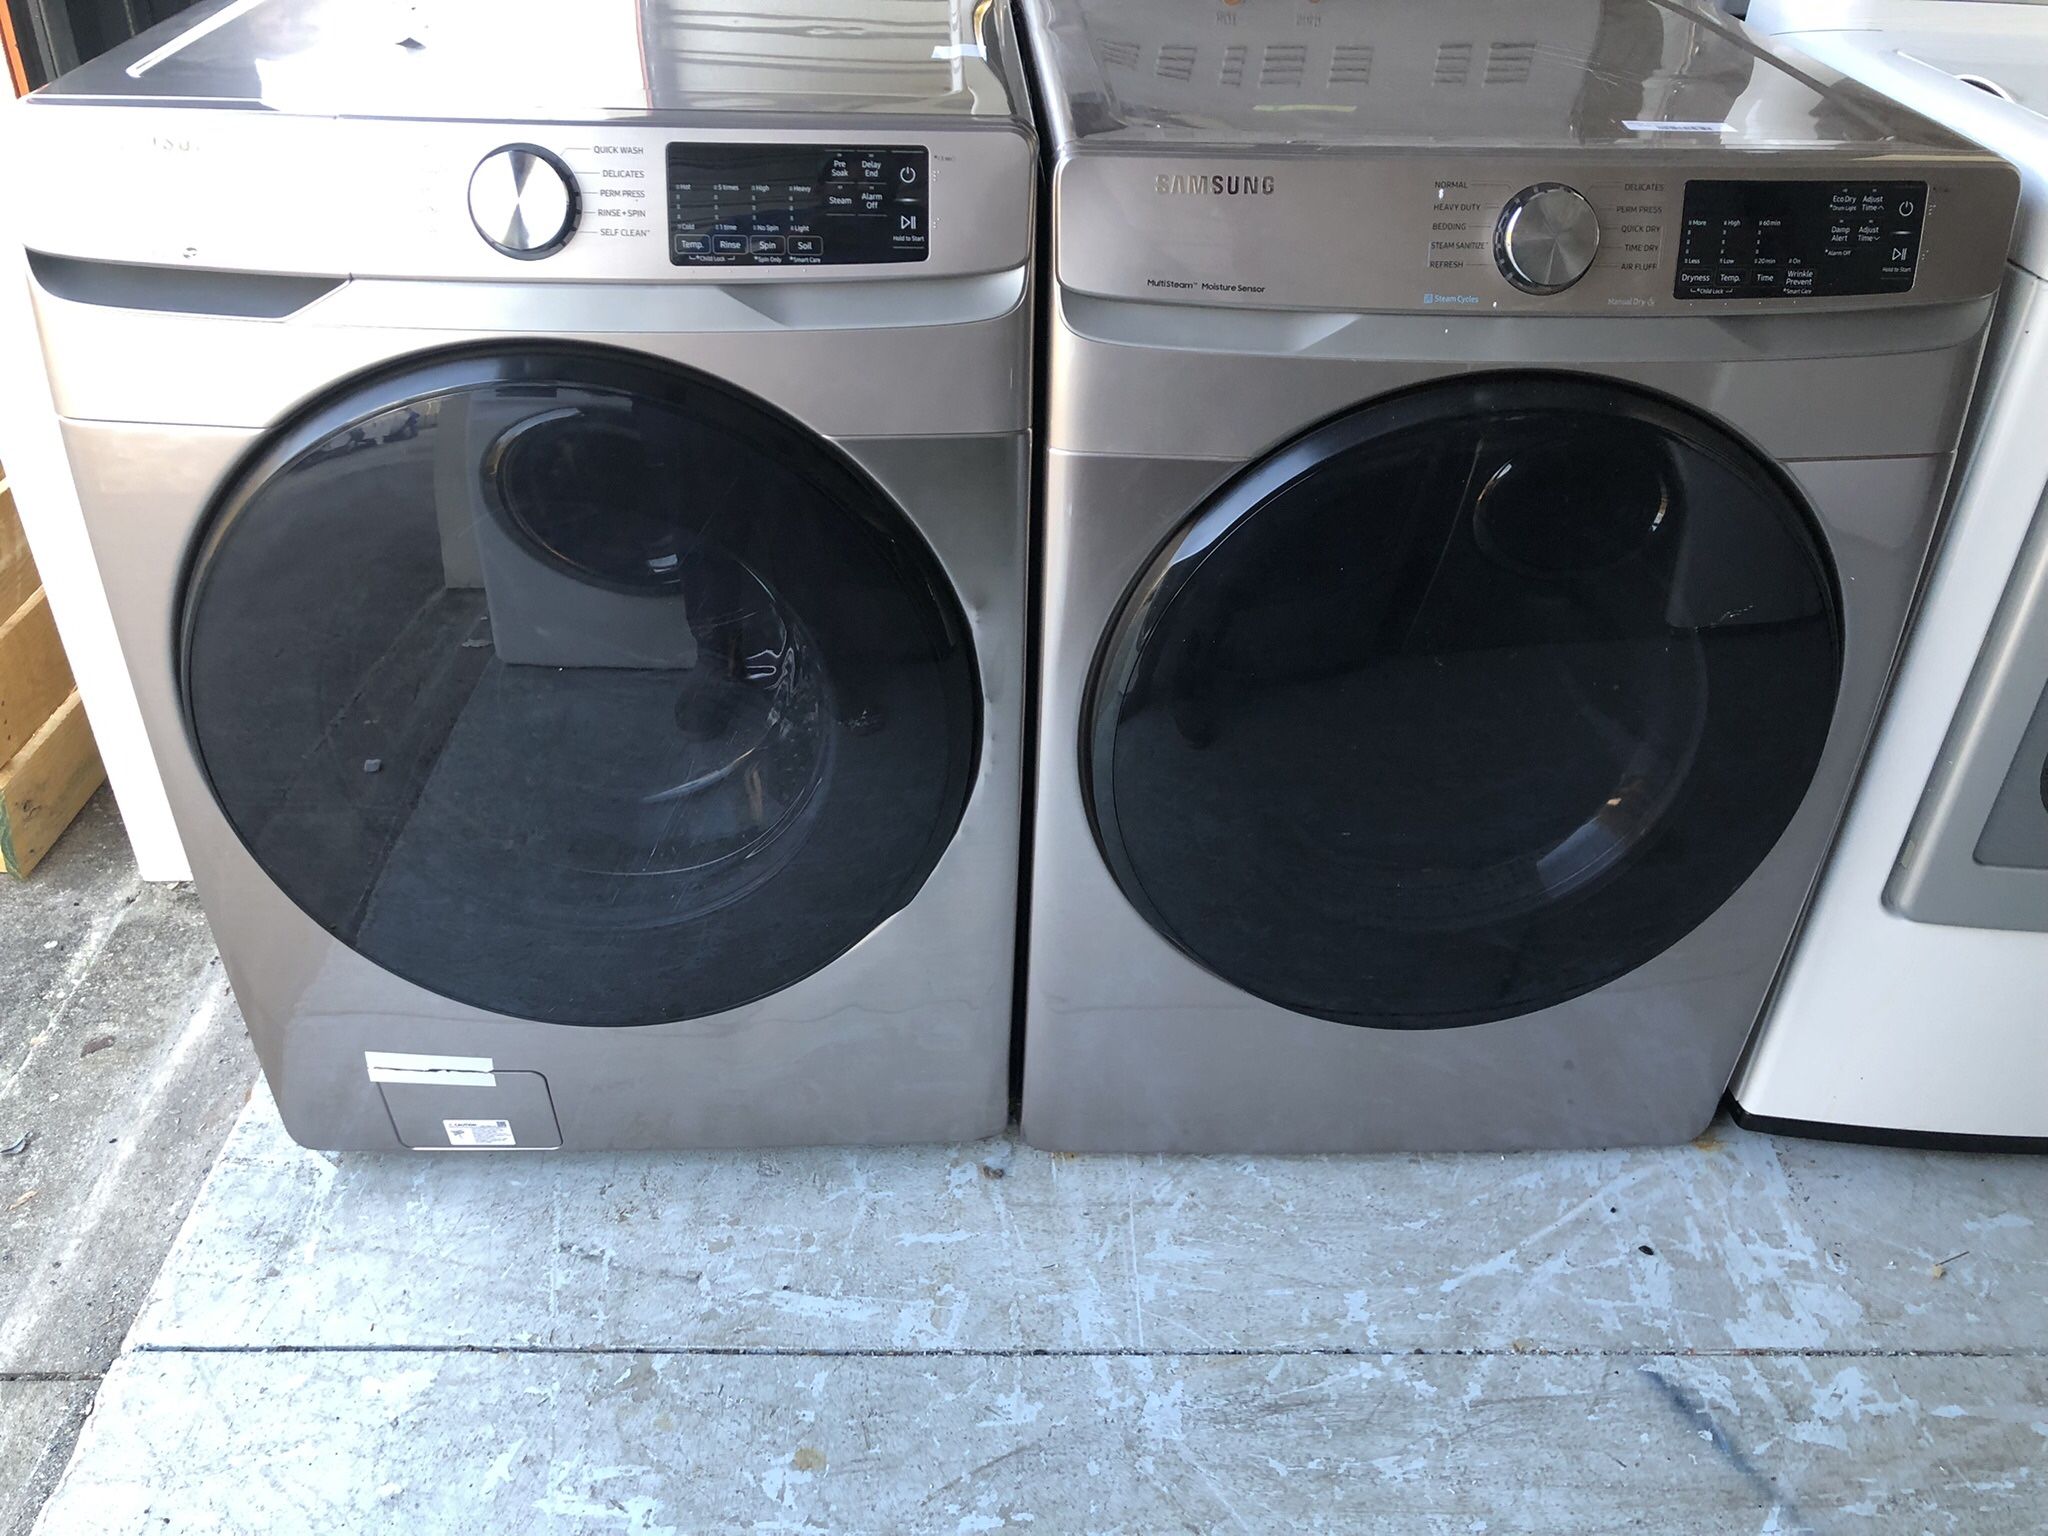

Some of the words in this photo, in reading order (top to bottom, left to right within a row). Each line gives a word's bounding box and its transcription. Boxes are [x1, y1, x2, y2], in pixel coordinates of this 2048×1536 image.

[593, 145, 619, 155] QUICK
[619, 146, 644, 155] WASH
[833, 160, 846, 168] Pre
[861, 160, 881, 170] Delay
[602, 169, 645, 179] DELICATES
[831, 168, 848, 177] Soak
[865, 169, 879, 177] End
[680, 183, 692, 191] Hot
[756, 184, 771, 193] High
[794, 184, 812, 194] Heavy
[1154, 174, 1275, 195] SAMSUNG
[1434, 180, 1469, 189] NORMAL
[1624, 183, 1665, 192] DELICATES
[600, 188, 621, 197] PERM
[622, 189, 645, 198] PRESS
[861, 192, 883, 201] Alarm
[828, 196, 853, 205] Steam
[1862, 195, 1884, 204] Adjust
[865, 201, 878, 210] Off
[1433, 203, 1459, 212] HEAVY
[1460, 203, 1481, 212] DUTY
[1862, 203, 1878, 212] Time
[597, 208, 621, 217] RINSE
[627, 209, 646, 218] SPIN
[681, 223, 695, 231] Cold
[1432, 222, 1467, 231] BEDDING
[1727, 219, 1741, 228] High
[600, 228, 619, 237] SELF
[766, 224, 780, 233] Spin
[794, 224, 810, 233] Light
[1621, 224, 1645, 233] QUICK
[1645, 225, 1660, 233] DRY
[1831, 226, 1851, 235] Damp
[1858, 226, 1879, 235] Adjust
[1831, 234, 1848, 242] Alert
[1857, 234, 1873, 242] Time
[720, 240, 741, 249] Rinse
[759, 241, 777, 252] Spin
[797, 242, 813, 251] Soil
[1430, 241, 1455, 250] STEAM
[1625, 244, 1643, 252] TIME
[1643, 244, 1659, 252] DRY
[1429, 260, 1464, 269] REFRESH
[1688, 257, 1701, 265] Less
[1792, 257, 1802, 265] On
[1620, 263, 1634, 271] AIR
[1634, 263, 1658, 272] FLUFF
[1681, 273, 1711, 283] Dryness
[1757, 273, 1774, 282] Time
[1787, 269, 1814, 278] Wrinkle
[1785, 277, 1813, 286] Prevent
[1201, 282, 1237, 292] Moisture
[1237, 284, 1266, 294] Sensor
[1434, 294, 1457, 303] Steam
[1457, 294, 1479, 305] Cycles
